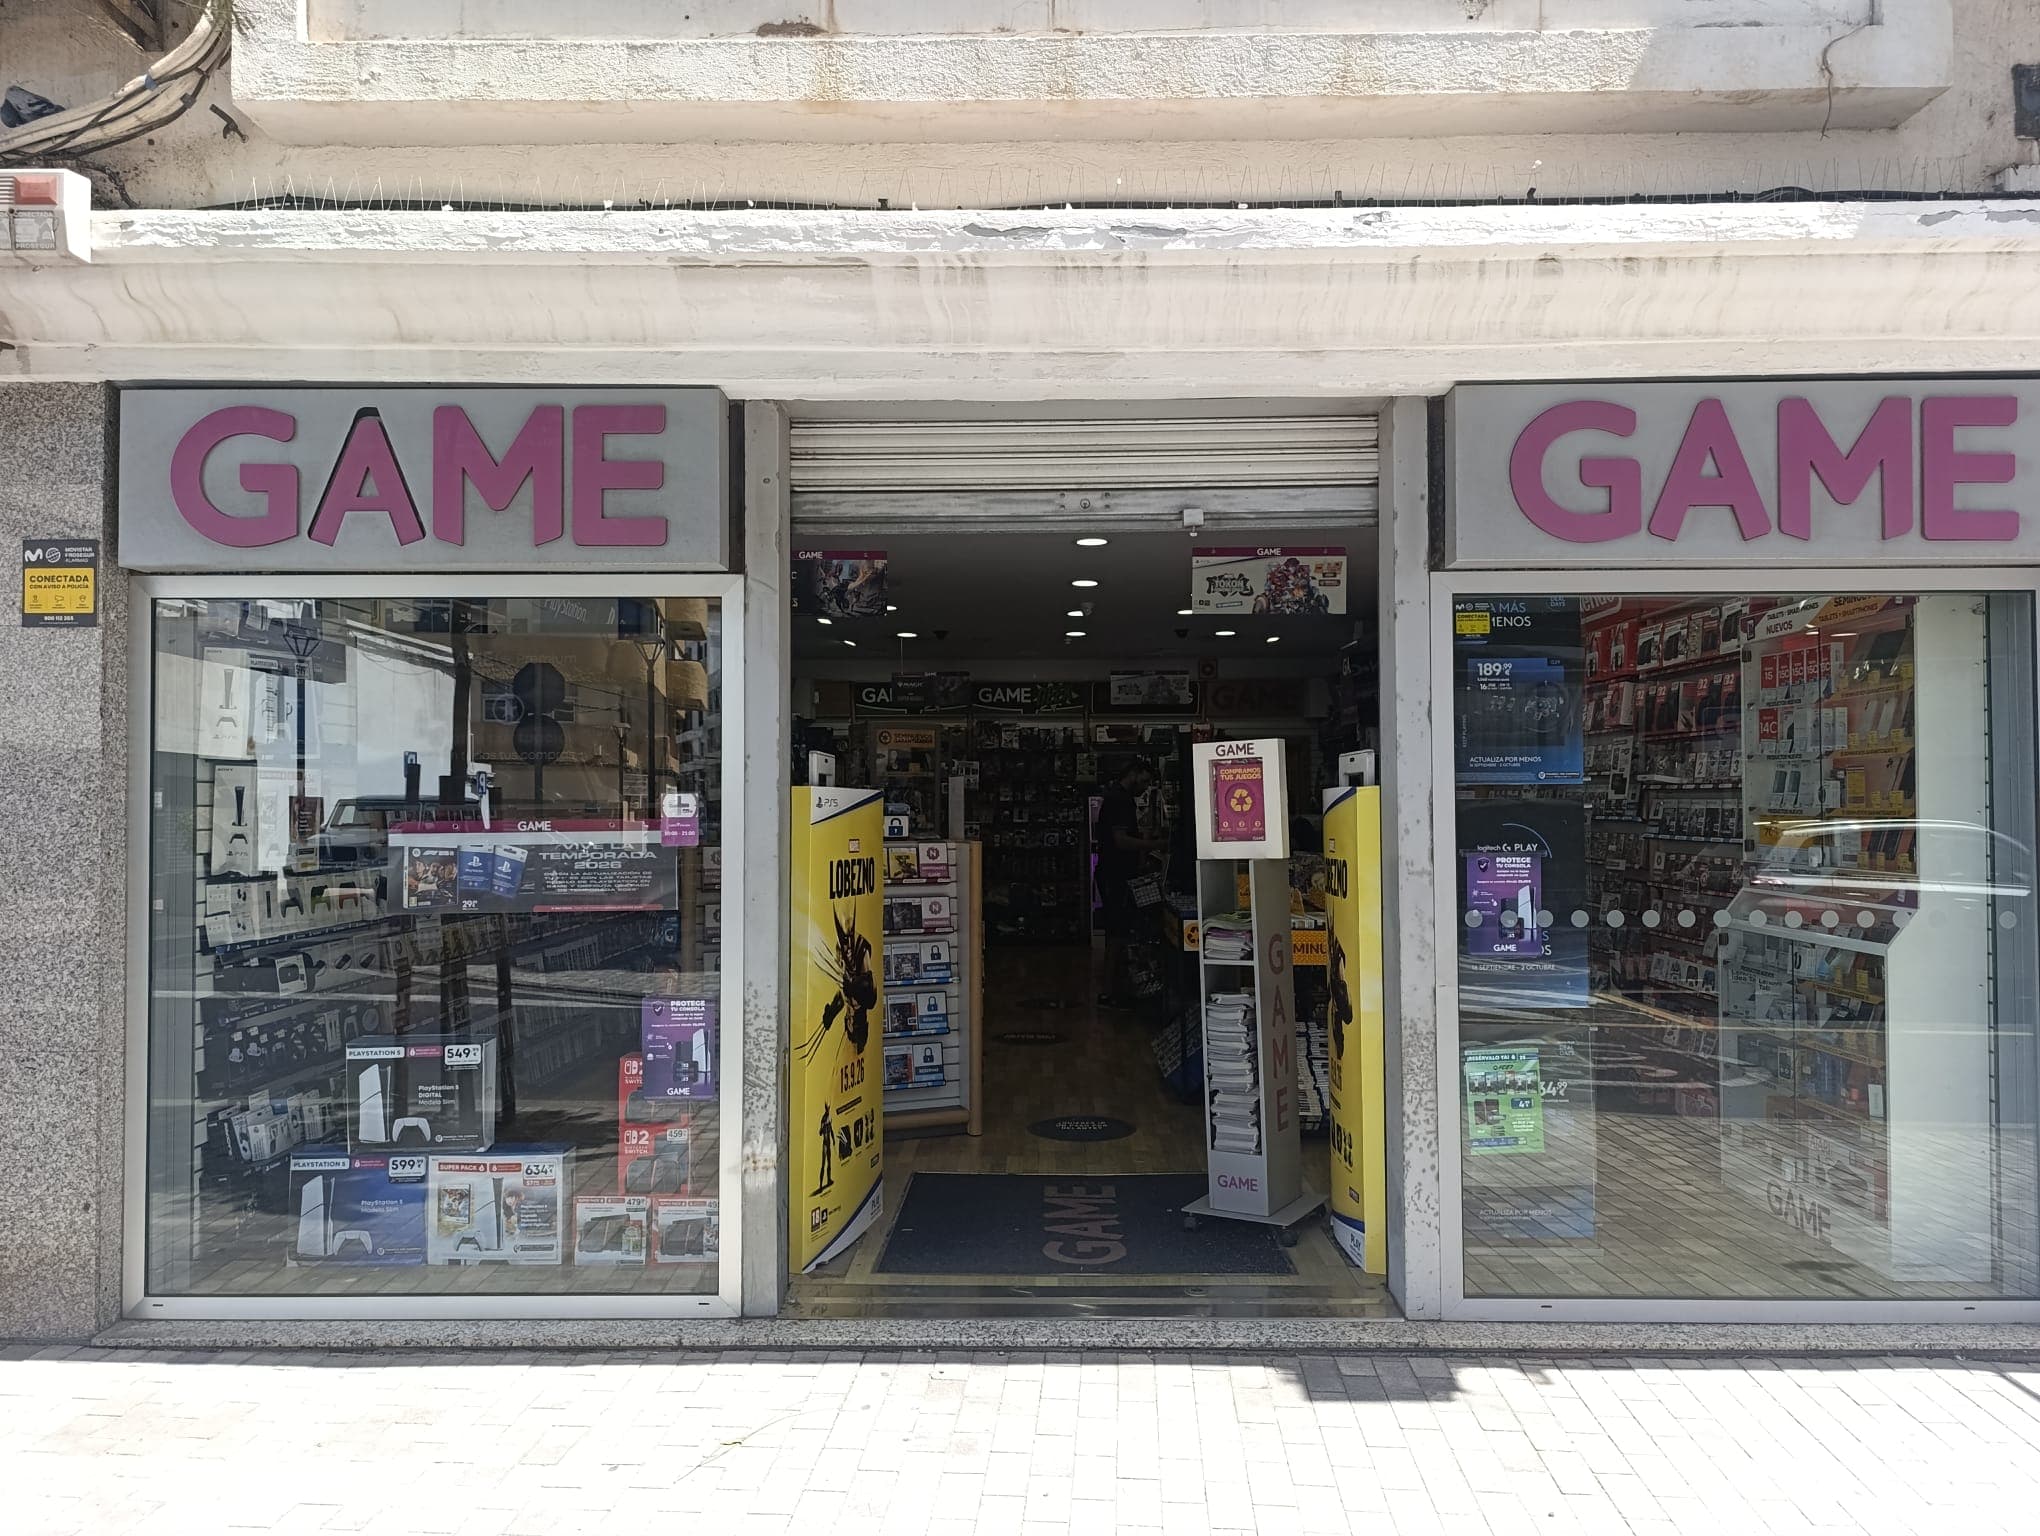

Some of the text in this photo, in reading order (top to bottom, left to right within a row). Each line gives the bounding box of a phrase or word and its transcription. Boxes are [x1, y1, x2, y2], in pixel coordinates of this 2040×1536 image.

[170, 405, 669, 547] GAME
[1509, 395, 2020, 543] GAME
[1500, 600, 1527, 613] MÁS
[1766, 620, 1793, 635] NUEVOS
[862, 688, 892, 703] GA
[978, 688, 1032, 703] GAME
[1216, 742, 1255, 756] GAME
[824, 798, 838, 807] PS5
[518, 820, 552, 832] GAME
[1476, 844, 1501, 852] logitech
[1514, 844, 1538, 852] PLAY
[538, 852, 657, 860] TEMPORADA
[574, 861, 622, 870] 2026
[830, 857, 875, 900] LOBEZNO
[1493, 944, 1518, 952] GAME
[840, 1058, 865, 1094] 15.9.26
[667, 1088, 690, 1096] GAME
[638, 1130, 650, 1144] 2
[1217, 1174, 1259, 1192] GAME
[1767, 1180, 1831, 1247] GAME
[1041, 1184, 1128, 1266] GAME
